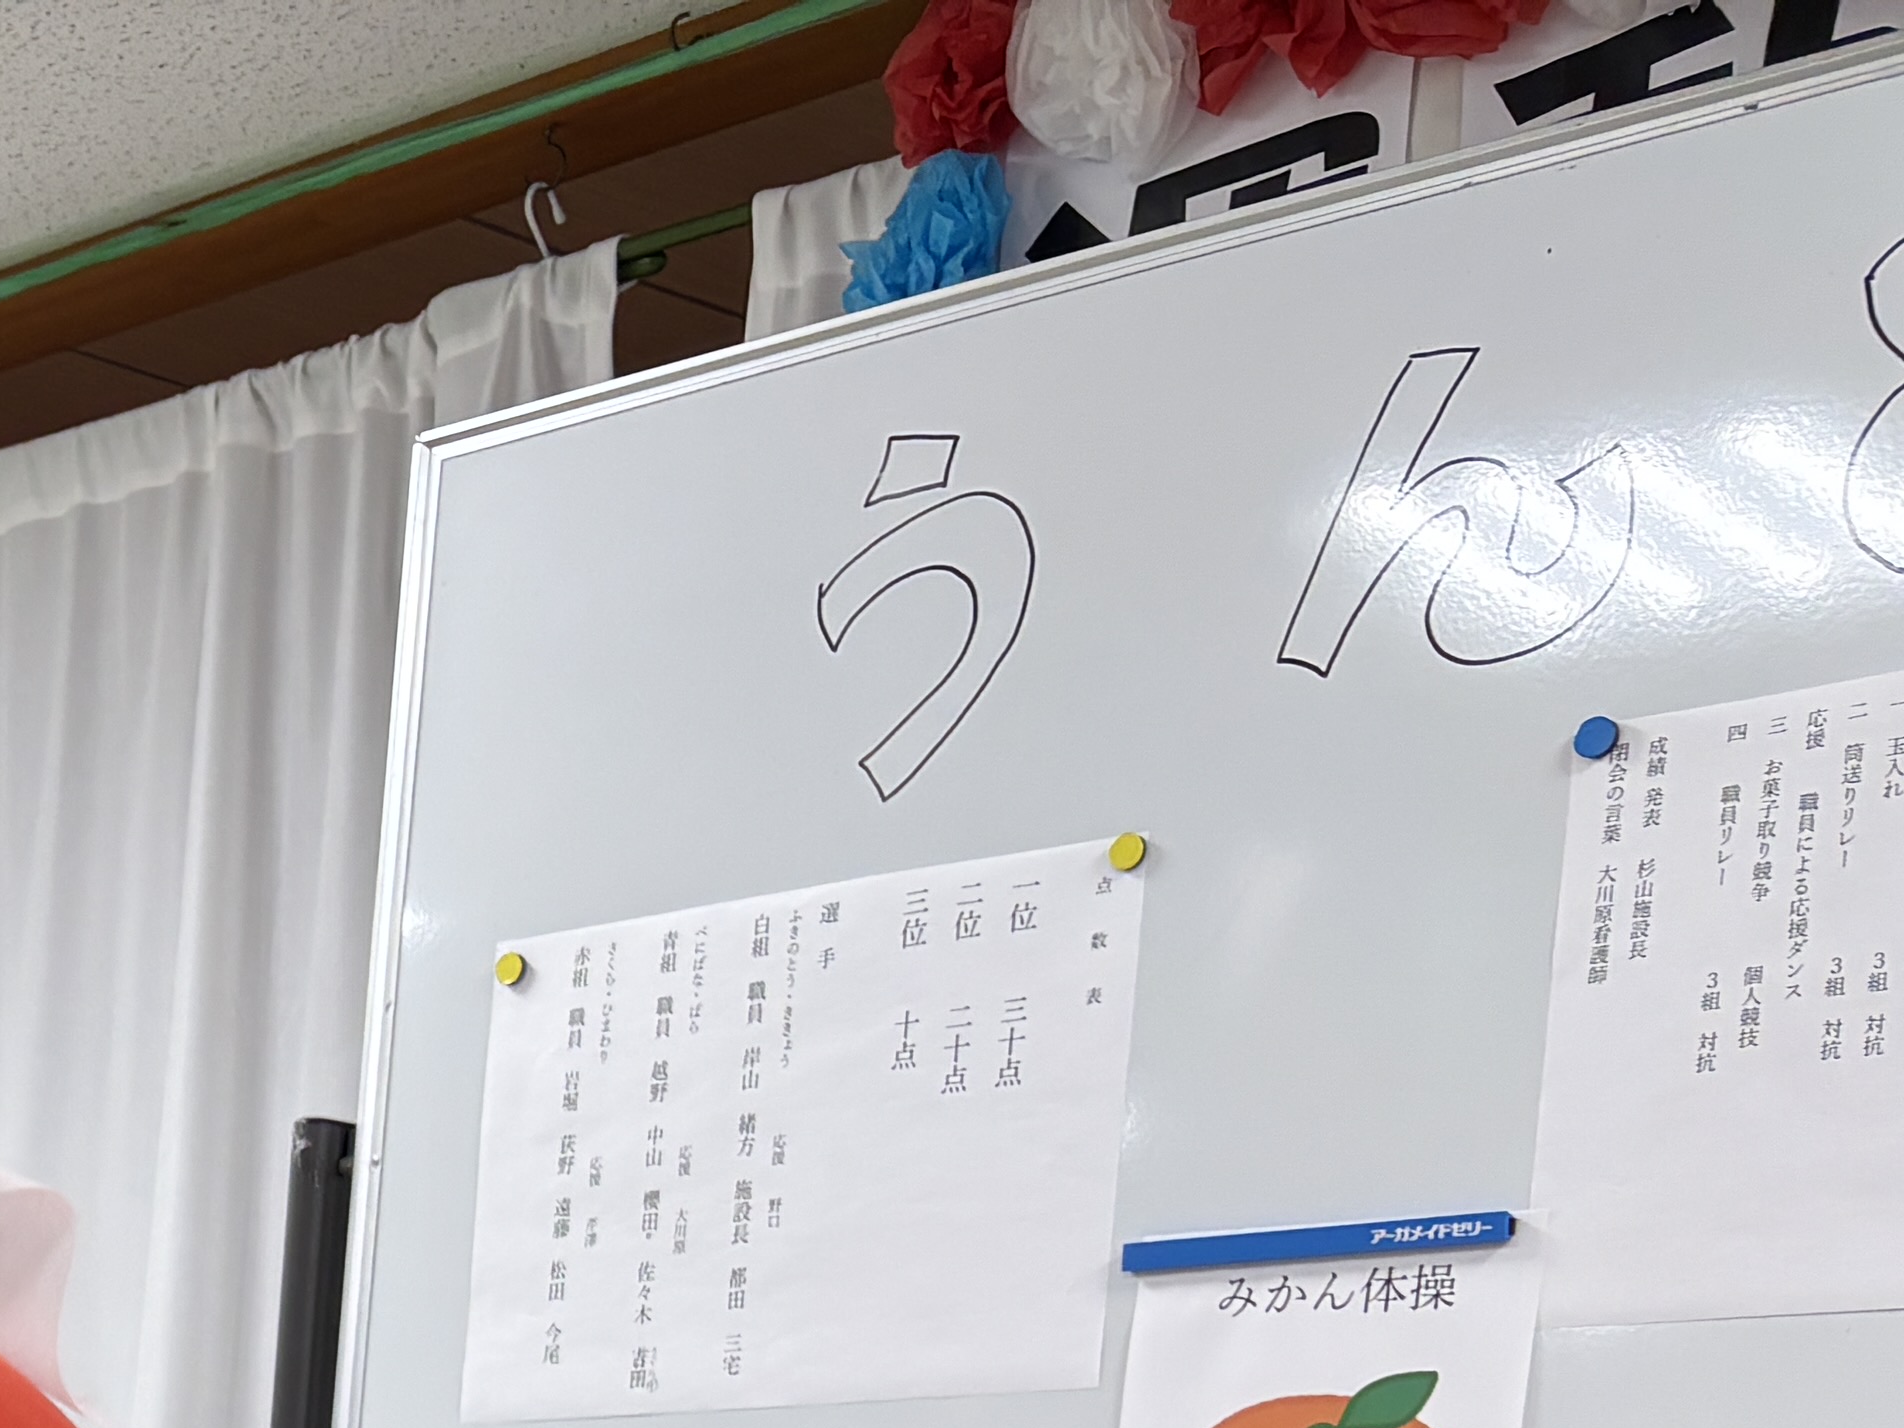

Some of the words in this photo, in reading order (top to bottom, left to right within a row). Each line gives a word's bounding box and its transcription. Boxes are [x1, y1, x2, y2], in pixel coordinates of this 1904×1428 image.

[817, 236, 1904, 801] うん
[1726, 723, 1748, 743] 四
[1768, 716, 1787, 735] 三
[1805, 708, 1829, 750] 応援
[1847, 702, 1868, 720] 二
[1751, 760, 1784, 902] お菓子取り競争
[1839, 743, 1867, 868] 筒送りリレー
[1718, 784, 1741, 886] 職員リレー
[902, 889, 929, 949] 三位
[955, 883, 983, 941] 二位
[1011, 881, 1040, 932] 一位
[1784, 791, 1820, 1000] 職員による応援ダンス
[1700, 972, 1721, 1011] 3組
[1824, 957, 1846, 997] 3組
[1867, 952, 1888, 993] 3組
[1738, 965, 1764, 1048] 個人競技
[891, 1010, 920, 1070] 十点
[941, 1006, 973, 1094] 二十点
[995, 996, 1027, 1087] 三十点
[1695, 1032, 1718, 1073] 対抗
[1820, 1019, 1843, 1061] 対抗
[1863, 1013, 1885, 1057] 対抗
[645, 1125, 663, 1167] 中山
[633, 1261, 656, 1325] 佐々木
[1218, 1263, 1456, 1317] みかん体操
